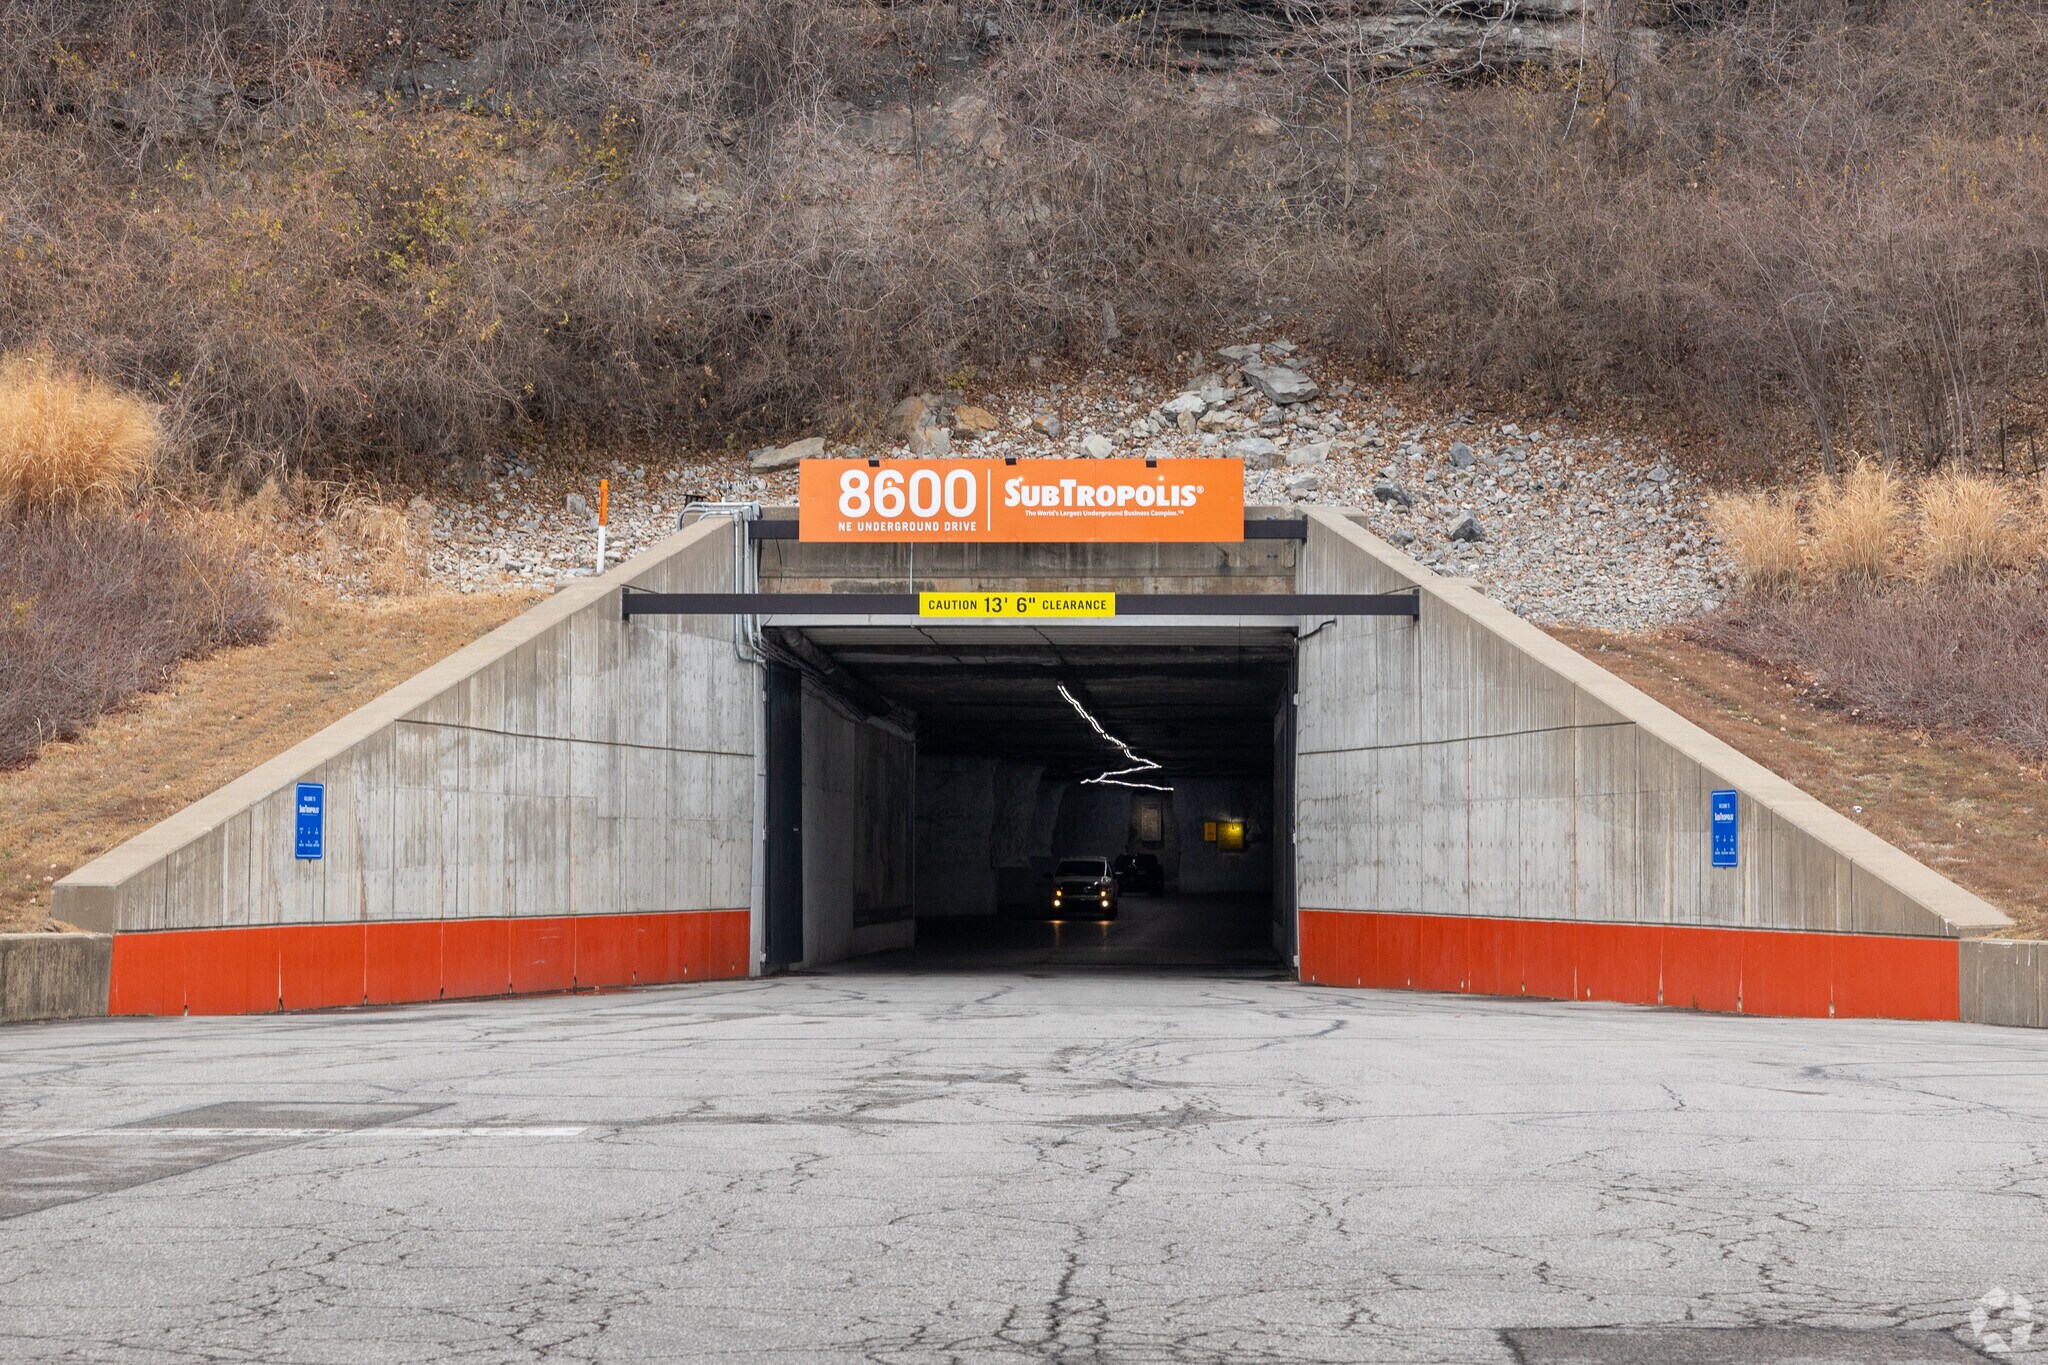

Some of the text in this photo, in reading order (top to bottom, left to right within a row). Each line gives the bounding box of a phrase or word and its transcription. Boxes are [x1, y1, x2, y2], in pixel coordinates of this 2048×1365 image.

[838, 468, 977, 518] 8600
[838, 521, 977, 532] NE UNDERGROUND DRIVE
[928, 597, 1107, 613] CAUTION 13' 6" CLEARANCE
